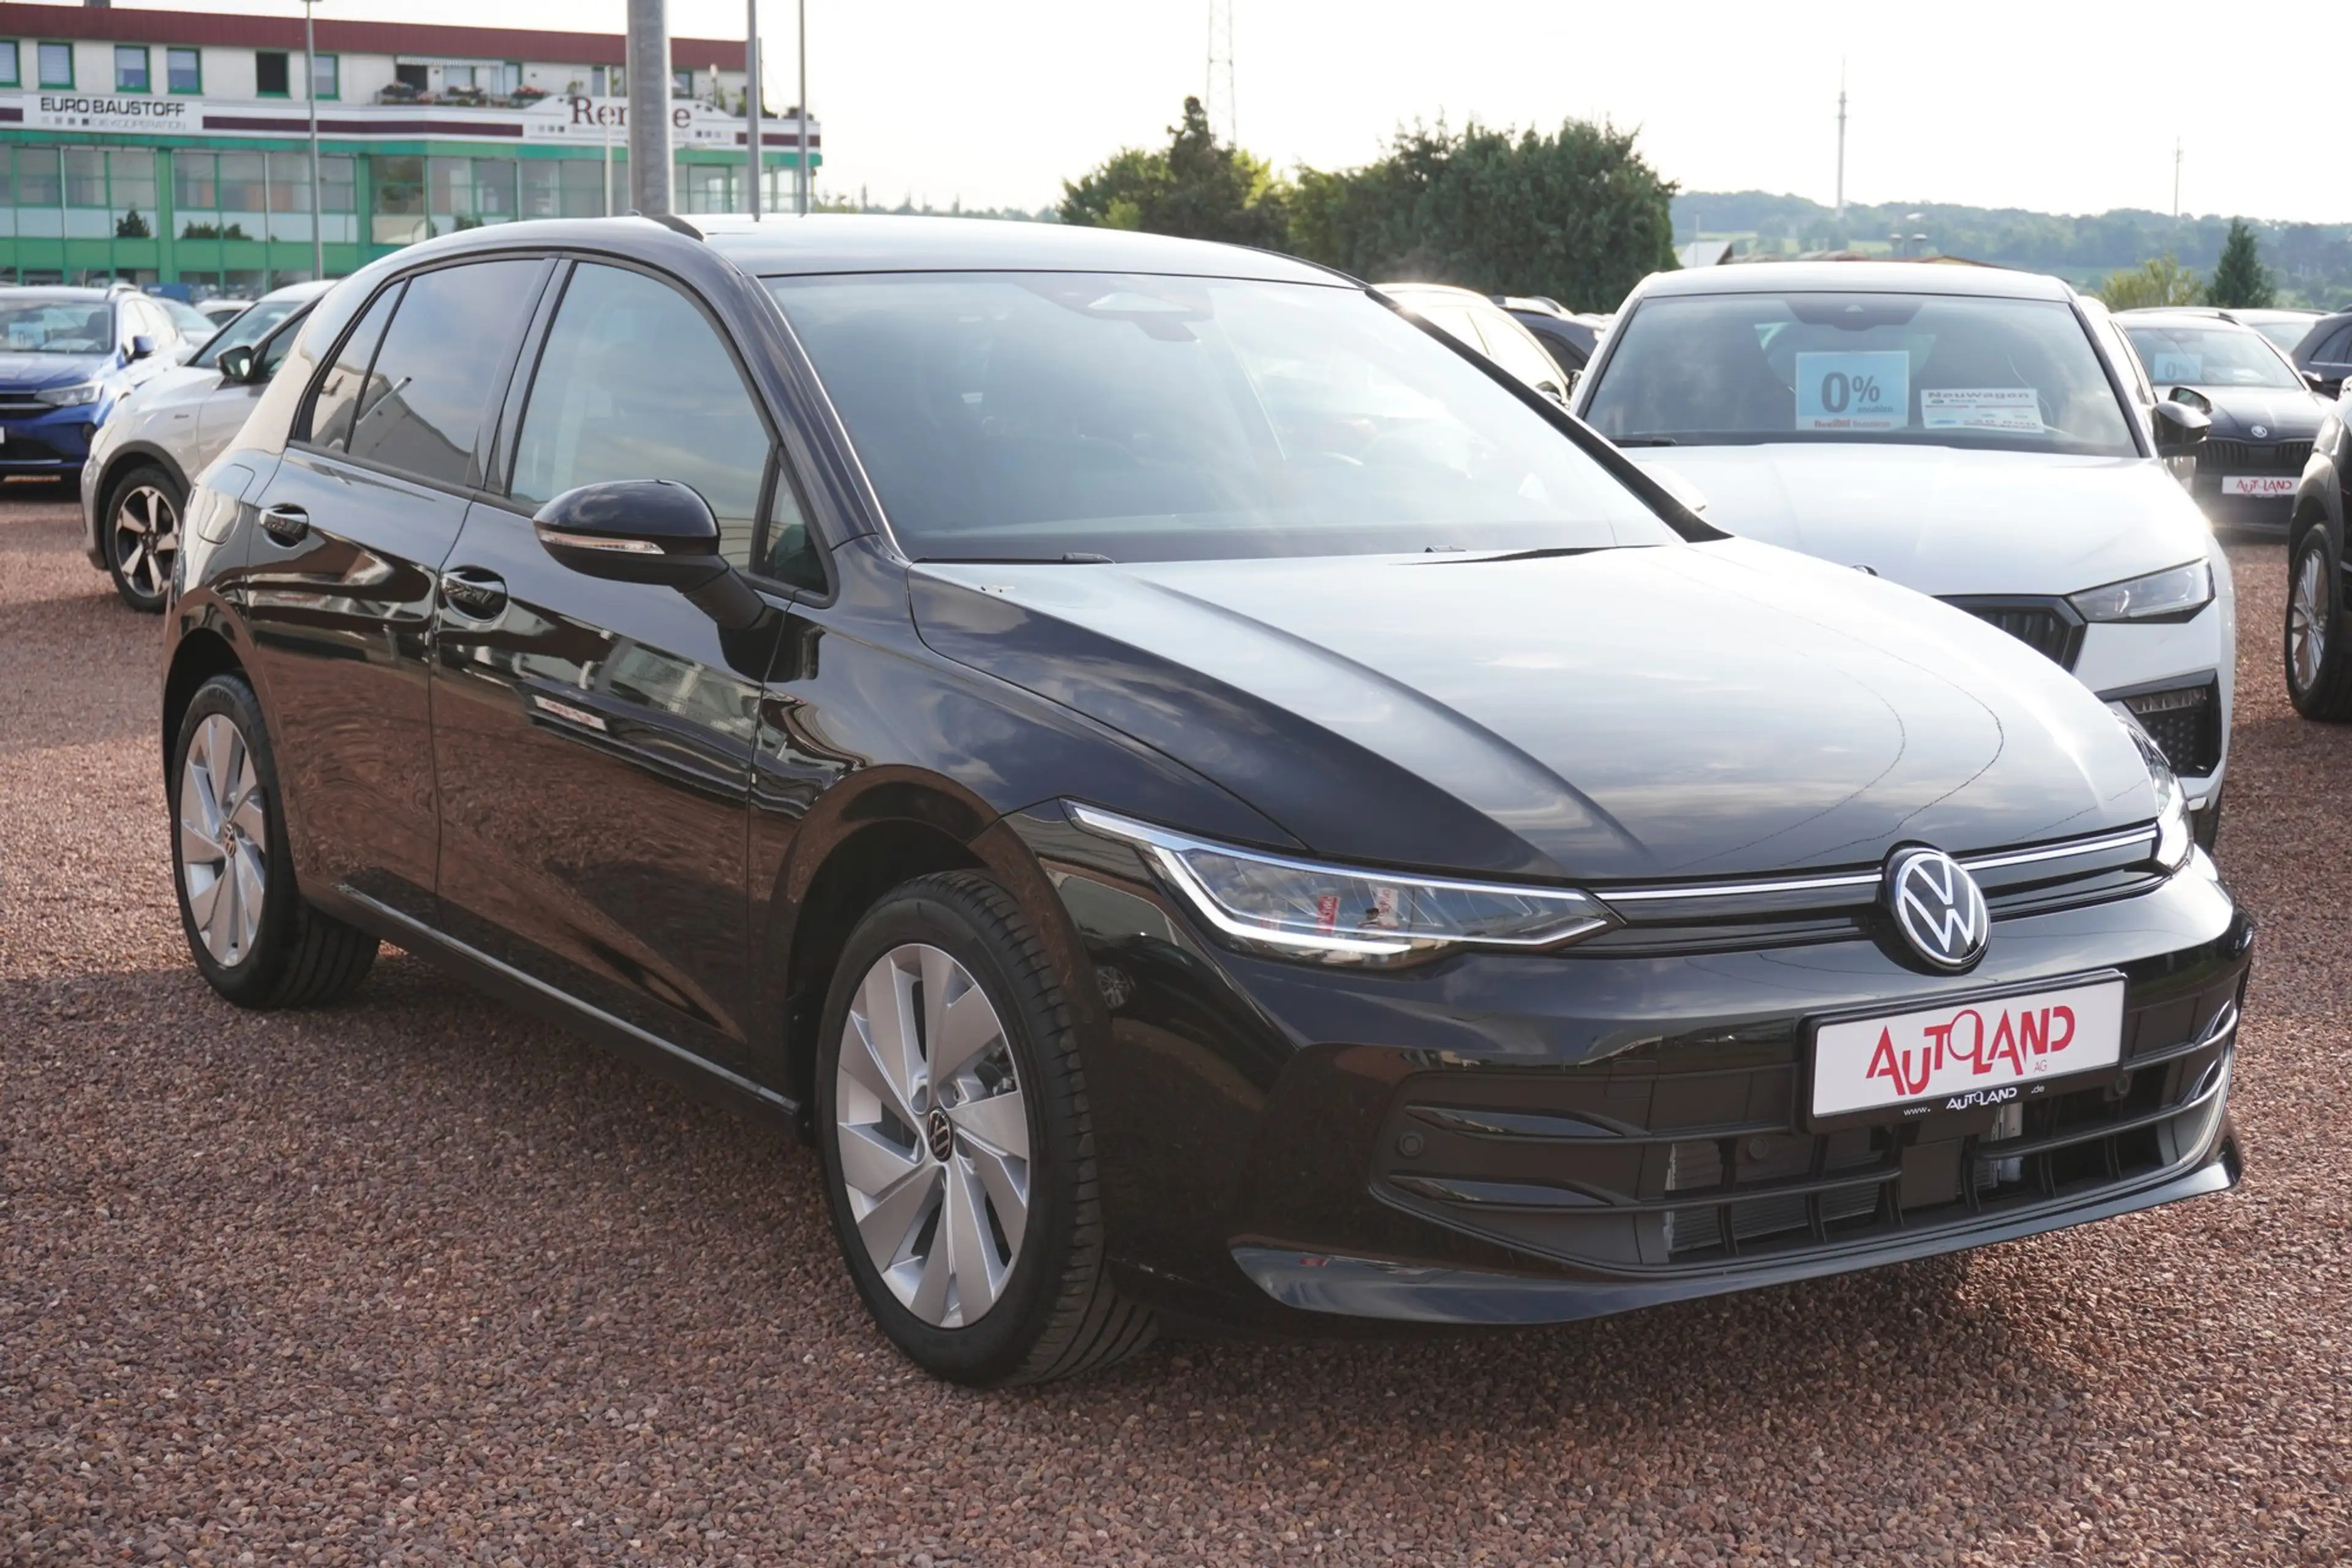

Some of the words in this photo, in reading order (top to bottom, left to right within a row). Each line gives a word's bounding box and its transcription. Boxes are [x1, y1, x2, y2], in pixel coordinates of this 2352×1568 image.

[41, 97, 89, 113] EURO
[93, 99, 186, 117] BAUSTOFF
[1821, 371, 1880, 413] 0%
[1866, 1005, 2076, 1096] AUTOLAND
[2033, 1060, 2048, 1073] AG
[1904, 1107, 1931, 1116] www.
